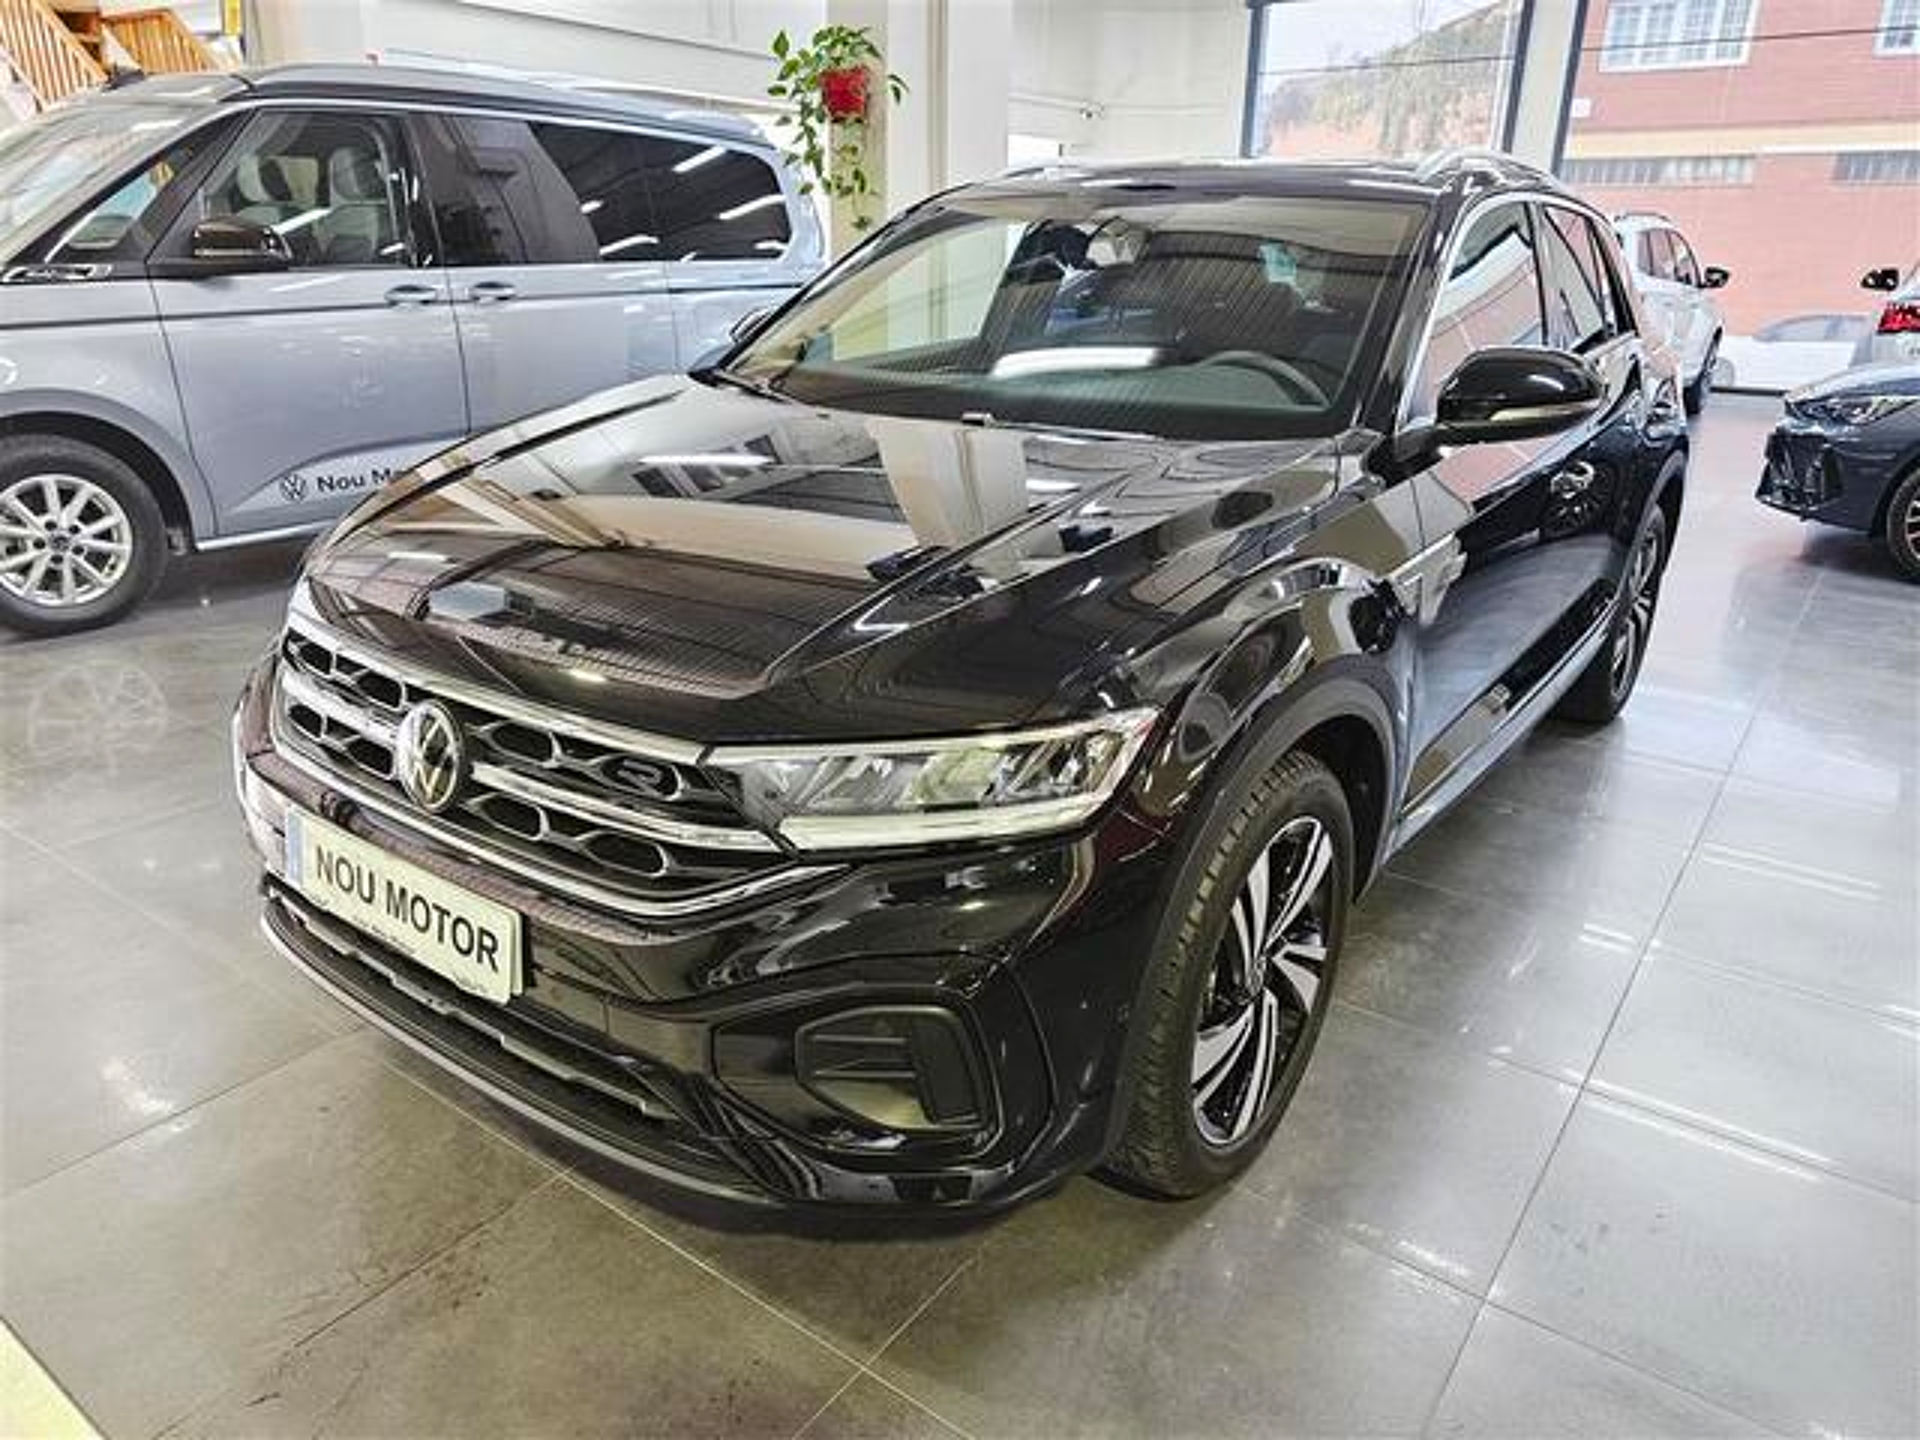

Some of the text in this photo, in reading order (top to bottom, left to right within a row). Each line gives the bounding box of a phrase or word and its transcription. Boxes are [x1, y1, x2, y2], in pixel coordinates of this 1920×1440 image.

[317, 475, 365, 493] Nou
[316, 846, 376, 904] NOU
[386, 880, 500, 973] MOTOR
